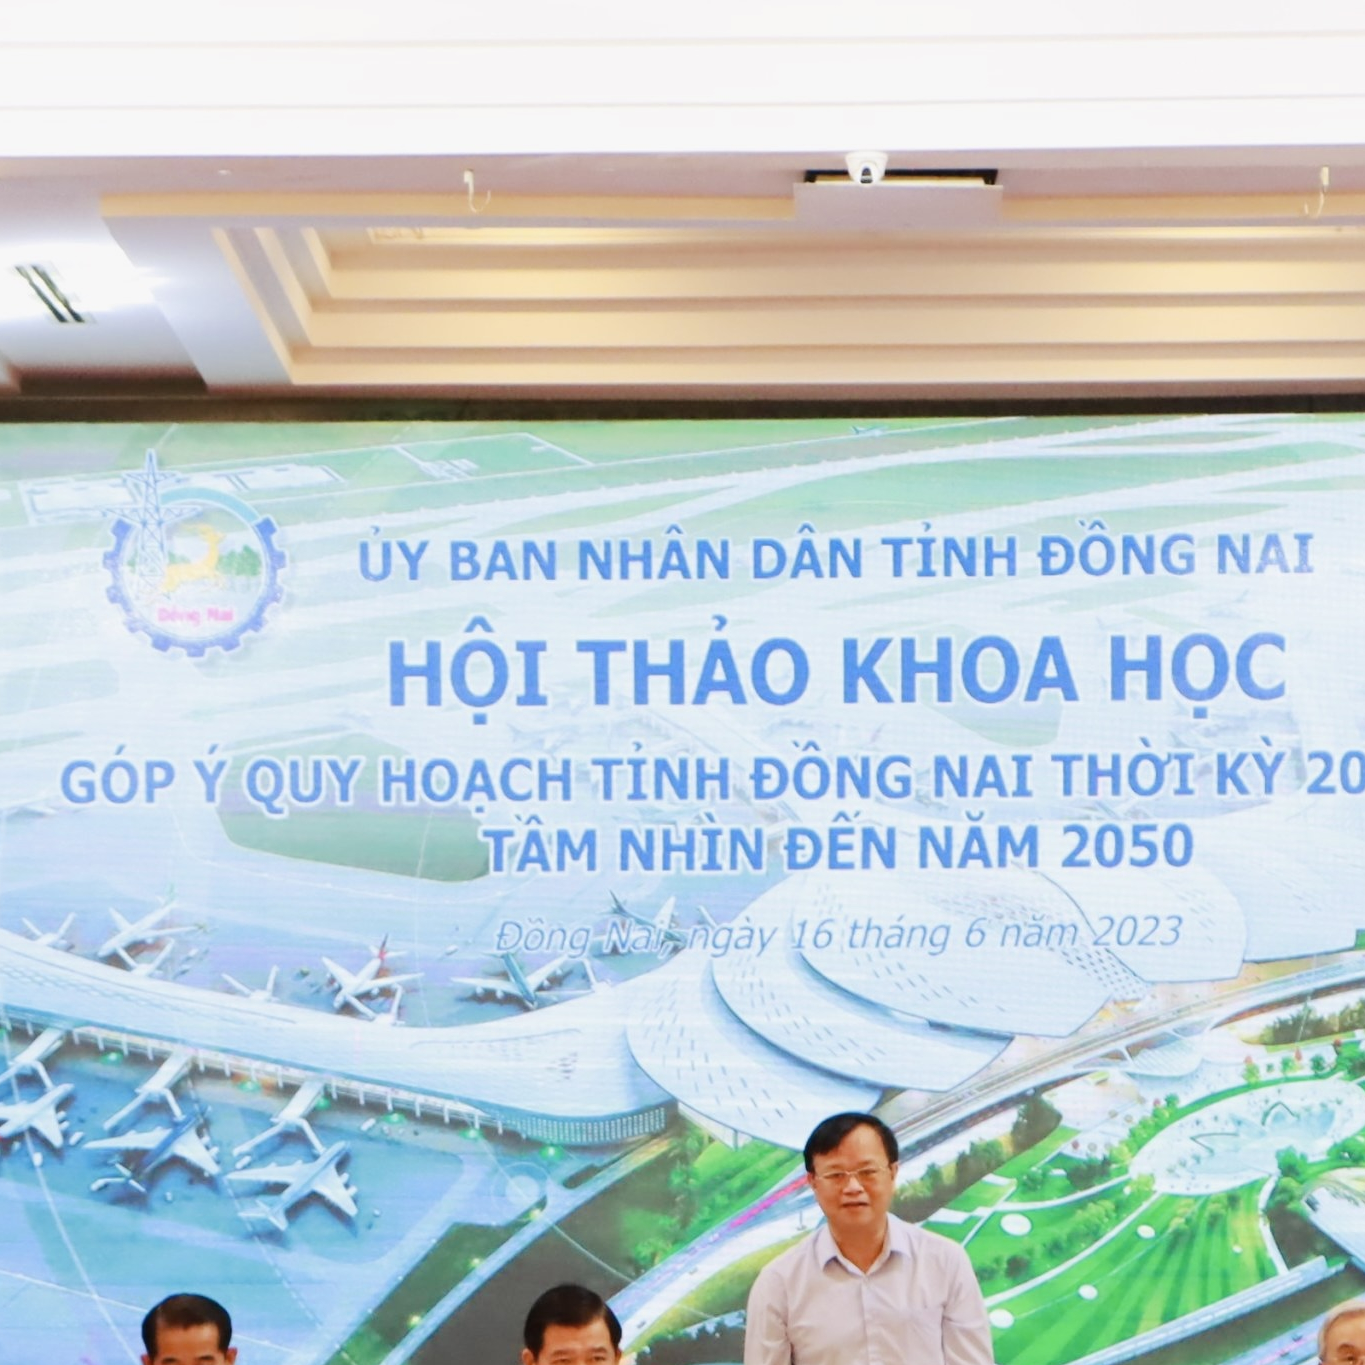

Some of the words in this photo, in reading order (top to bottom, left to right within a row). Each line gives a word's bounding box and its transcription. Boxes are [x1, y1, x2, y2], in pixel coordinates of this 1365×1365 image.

[359, 526, 429, 581] ỦY
[450, 540, 557, 581] BAN
[578, 524, 730, 580] NHÂN
[752, 523, 863, 579] DÂN
[881, 522, 1017, 577] TỈNH
[1037, 519, 1196, 576] ĐỒNG
[1217, 533, 1316, 575] NAI
[389, 616, 549, 725] HỘI
[576, 615, 811, 707] THẢO
[842, 635, 1080, 704] KHOA
[1110, 632, 1287, 719] HỌC
[60, 745, 175, 804] GÓP
[195, 744, 227, 802] Ý
[245, 758, 362, 814] QUY
[382, 757, 573, 813] HOẠCH
[591, 741, 731, 802] TỈNH
[750, 740, 913, 801] ĐỒNG
[933, 754, 1034, 799] NAI
[1051, 736, 1196, 798] THỜI
[1216, 735, 1287, 796] KỲ
[483, 814, 598, 873] TẦM
[619, 811, 765, 872] NHÌN
[784, 812, 897, 870] ĐẾN
[919, 811, 1040, 869] NĂM
[1062, 822, 1195, 869] 2050
[496, 918, 592, 959] Đồng
[607, 919, 673, 953] Nai,
[687, 919, 778, 958] ngày
[792, 920, 833, 948] 16
[847, 916, 951, 956] tháng
[964, 916, 985, 948] 6
[1001, 918, 1079, 948] năm
[1093, 915, 1184, 947] 2023
